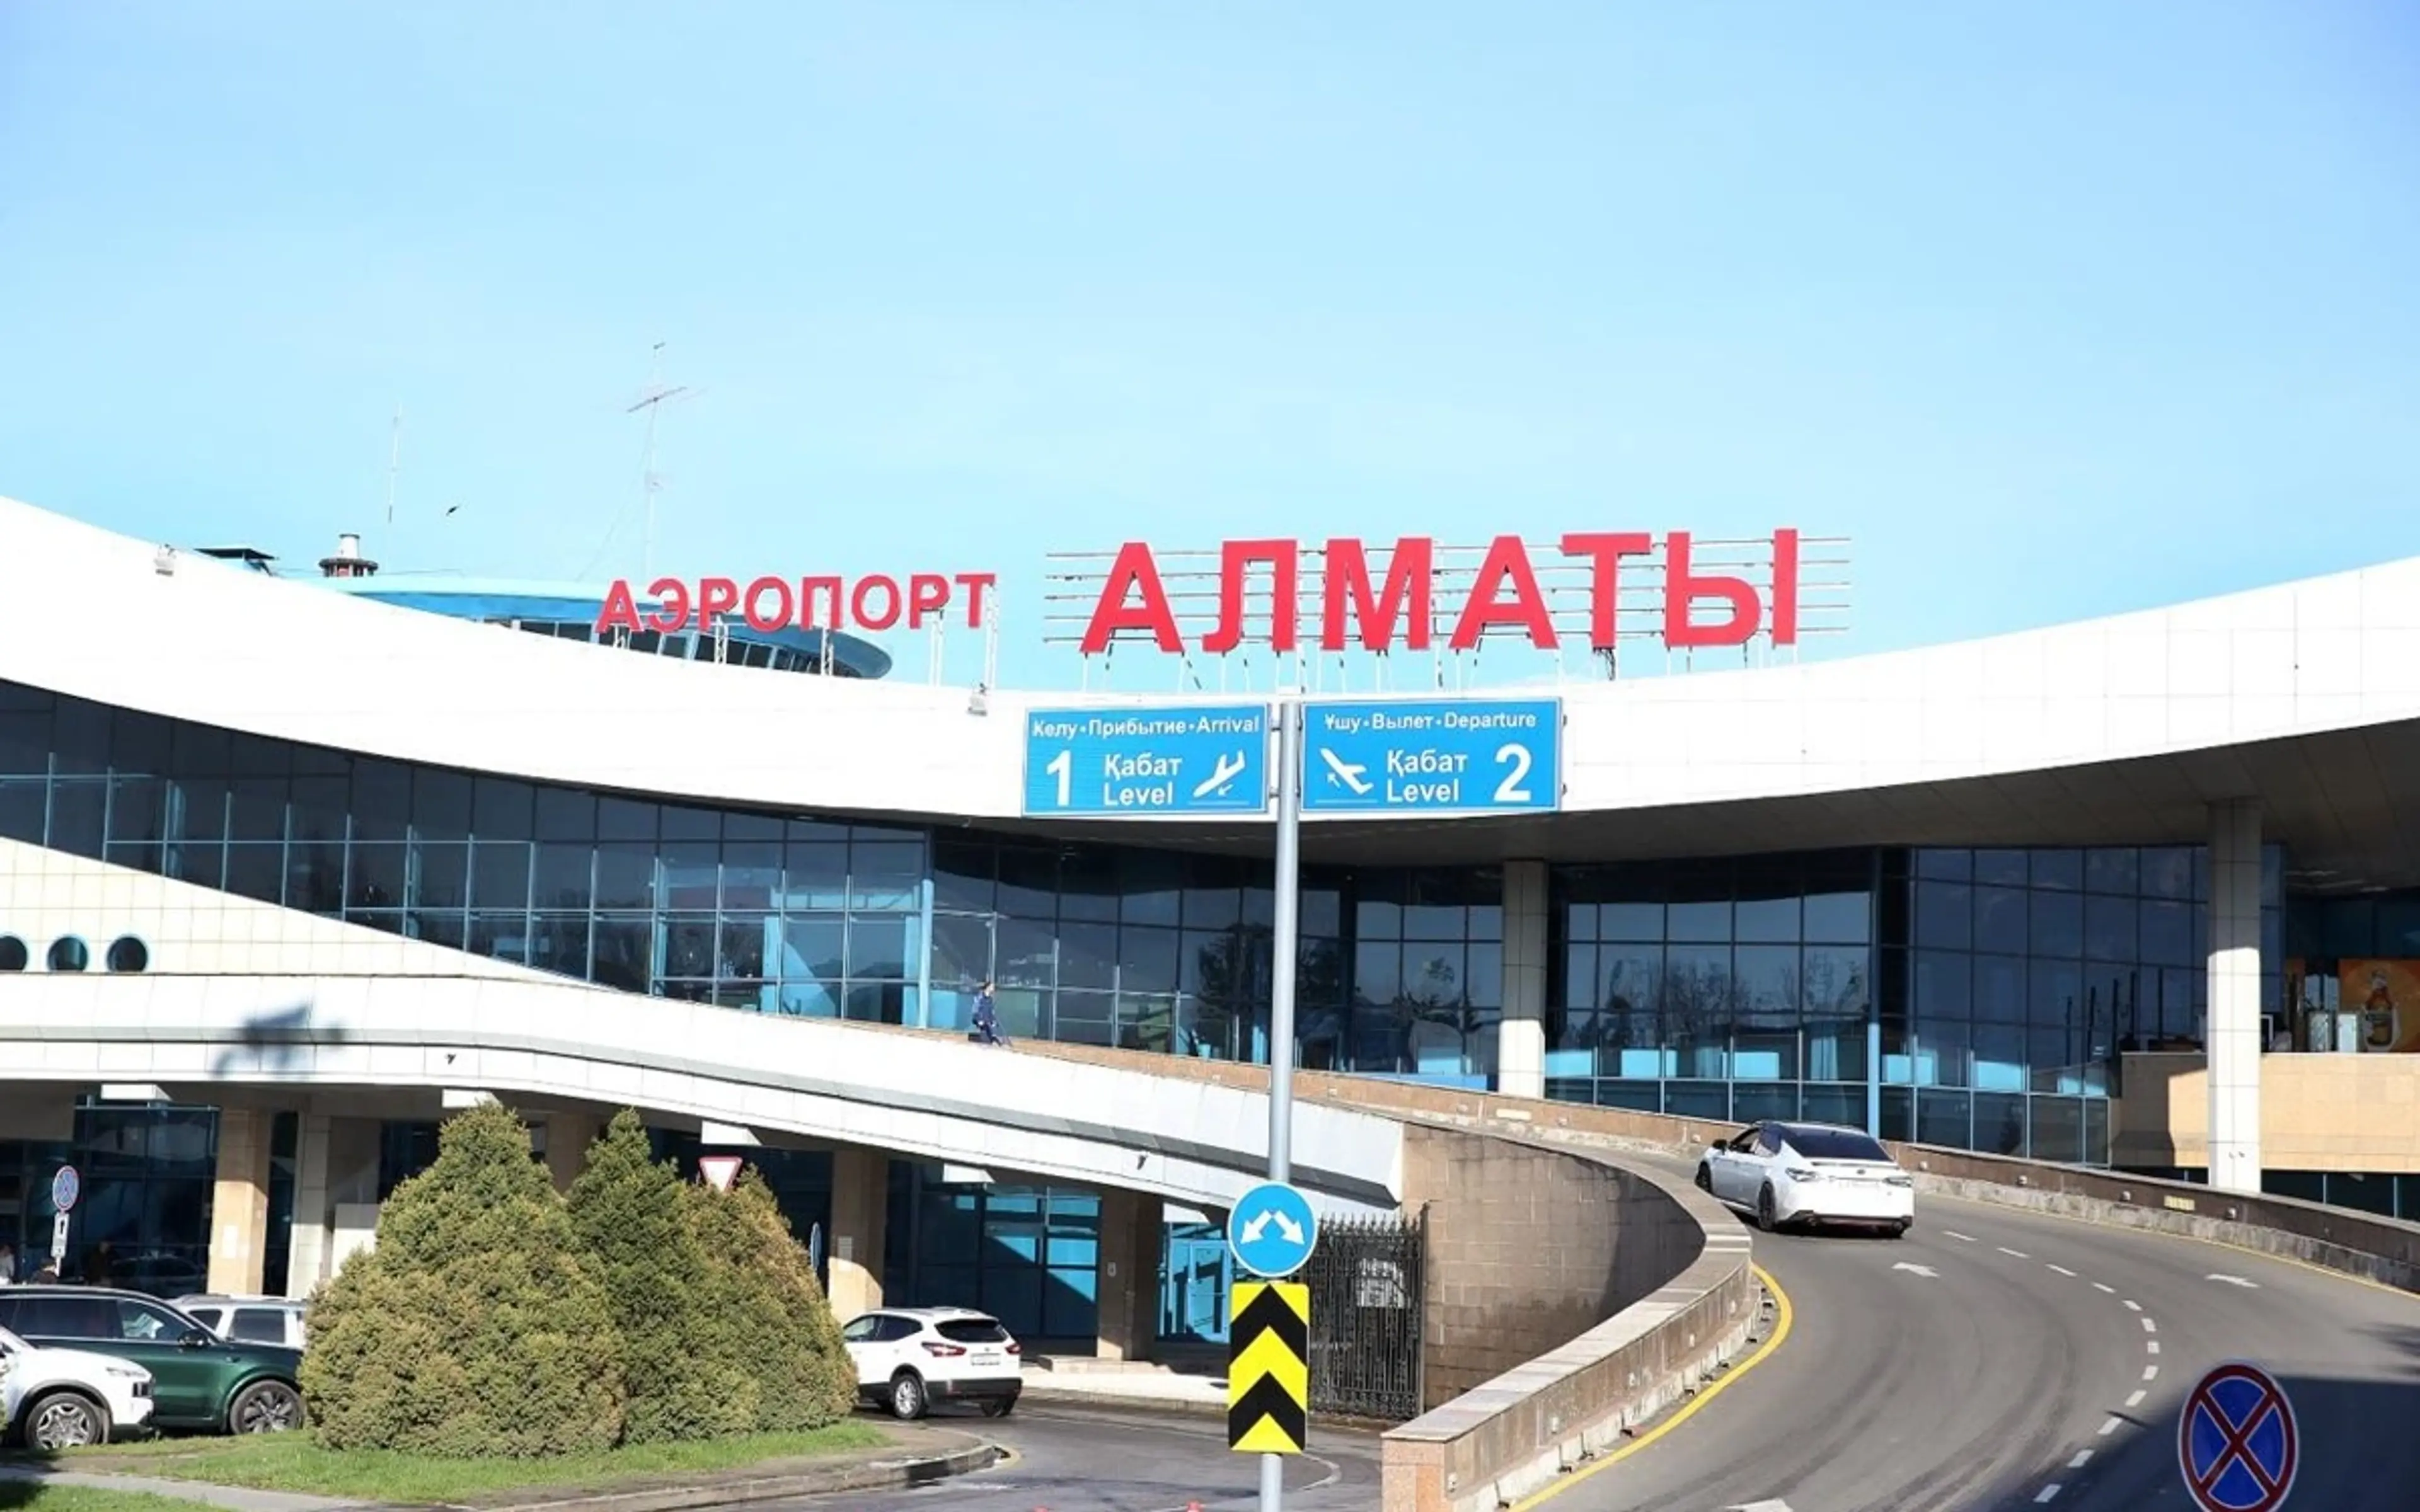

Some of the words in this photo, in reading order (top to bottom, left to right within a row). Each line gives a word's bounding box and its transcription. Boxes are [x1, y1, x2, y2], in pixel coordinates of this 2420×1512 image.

[598, 573, 994, 633] АЭРОПОРТ
[1082, 529, 1797, 653] АЛМАТЫ
[1047, 750, 1071, 806] 1
[1104, 752, 1182, 781] Қабат
[1387, 749, 1468, 777] Қабат
[1494, 743, 1531, 802] 2
[1104, 781, 1173, 806] Level
[1387, 779, 1459, 803] Level
